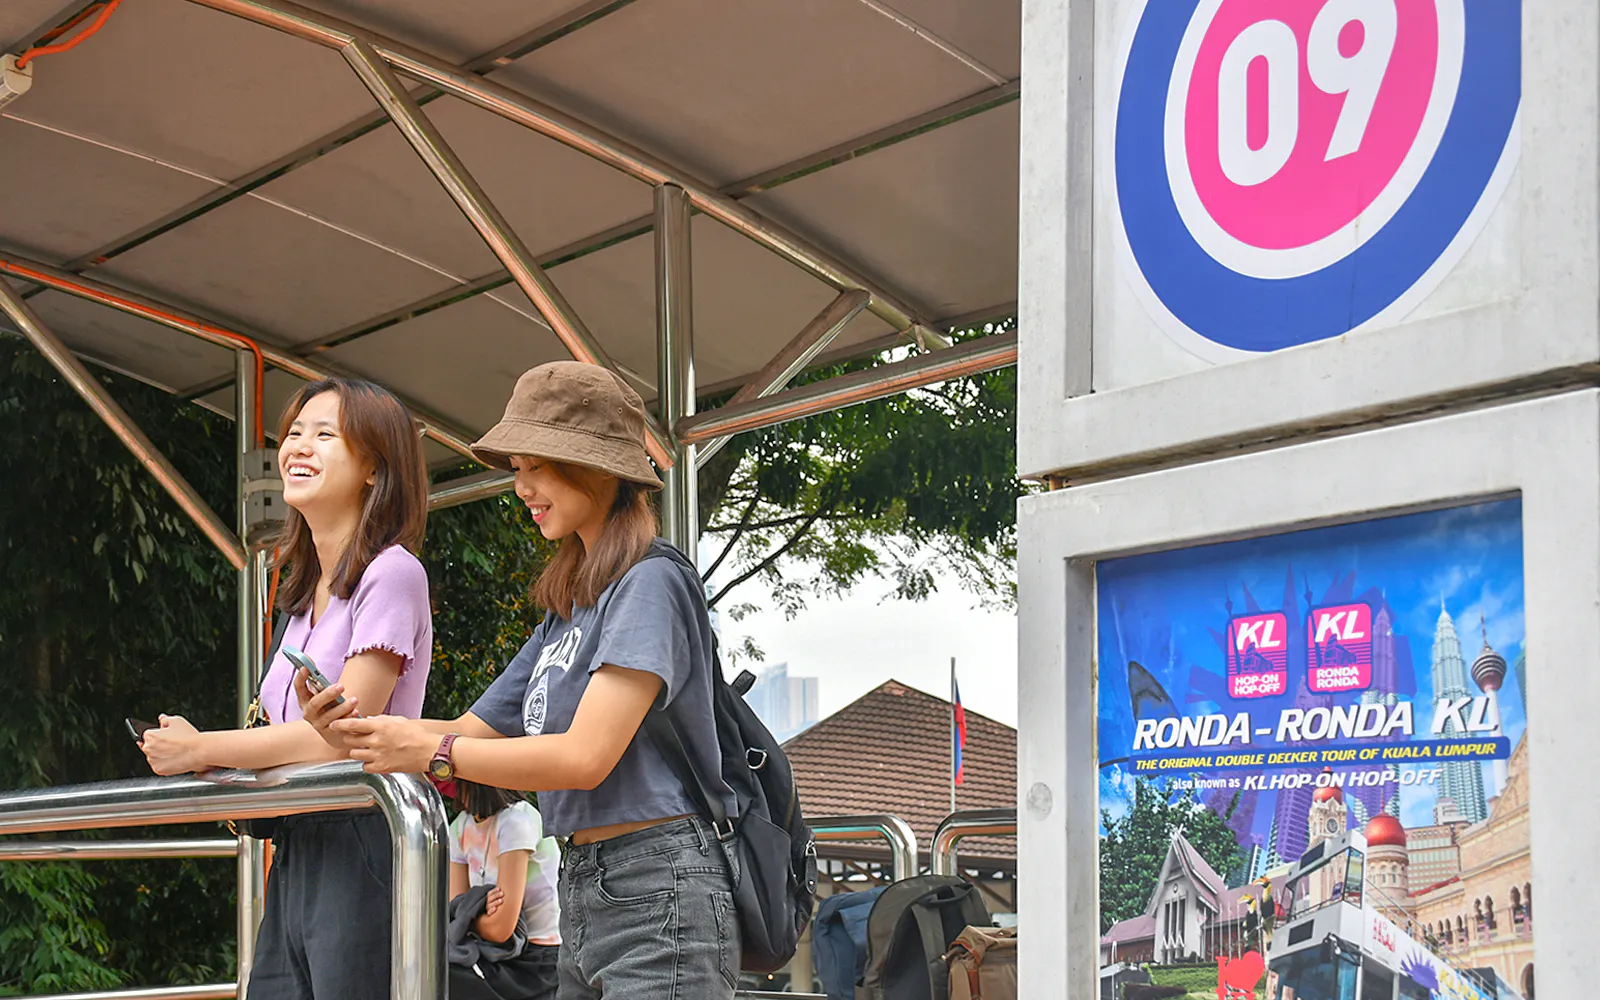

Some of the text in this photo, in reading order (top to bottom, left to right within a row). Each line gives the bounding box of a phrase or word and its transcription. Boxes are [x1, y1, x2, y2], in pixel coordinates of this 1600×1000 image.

[1217, 0, 1398, 187] 09
[1236, 619, 1281, 651] KL
[1315, 610, 1365, 643] KL
[1235, 673, 1279, 686] HOP-ON
[1316, 666, 1360, 679] RONDA
[1316, 676, 1360, 689] RONDA
[1234, 682, 1281, 695] HOP-OFF
[1430, 696, 1499, 735] KL
[1136, 742, 1497, 770] THE ORIGINAL DOUBLE DECKER TOUR OF KUALA LUMPUR
[1172, 778, 1193, 790] also
[1195, 778, 1227, 789] known
[1228, 778, 1240, 788] as
[1267, 771, 1346, 791] HOP-ON
[1348, 768, 1443, 787] HOP-OFF
